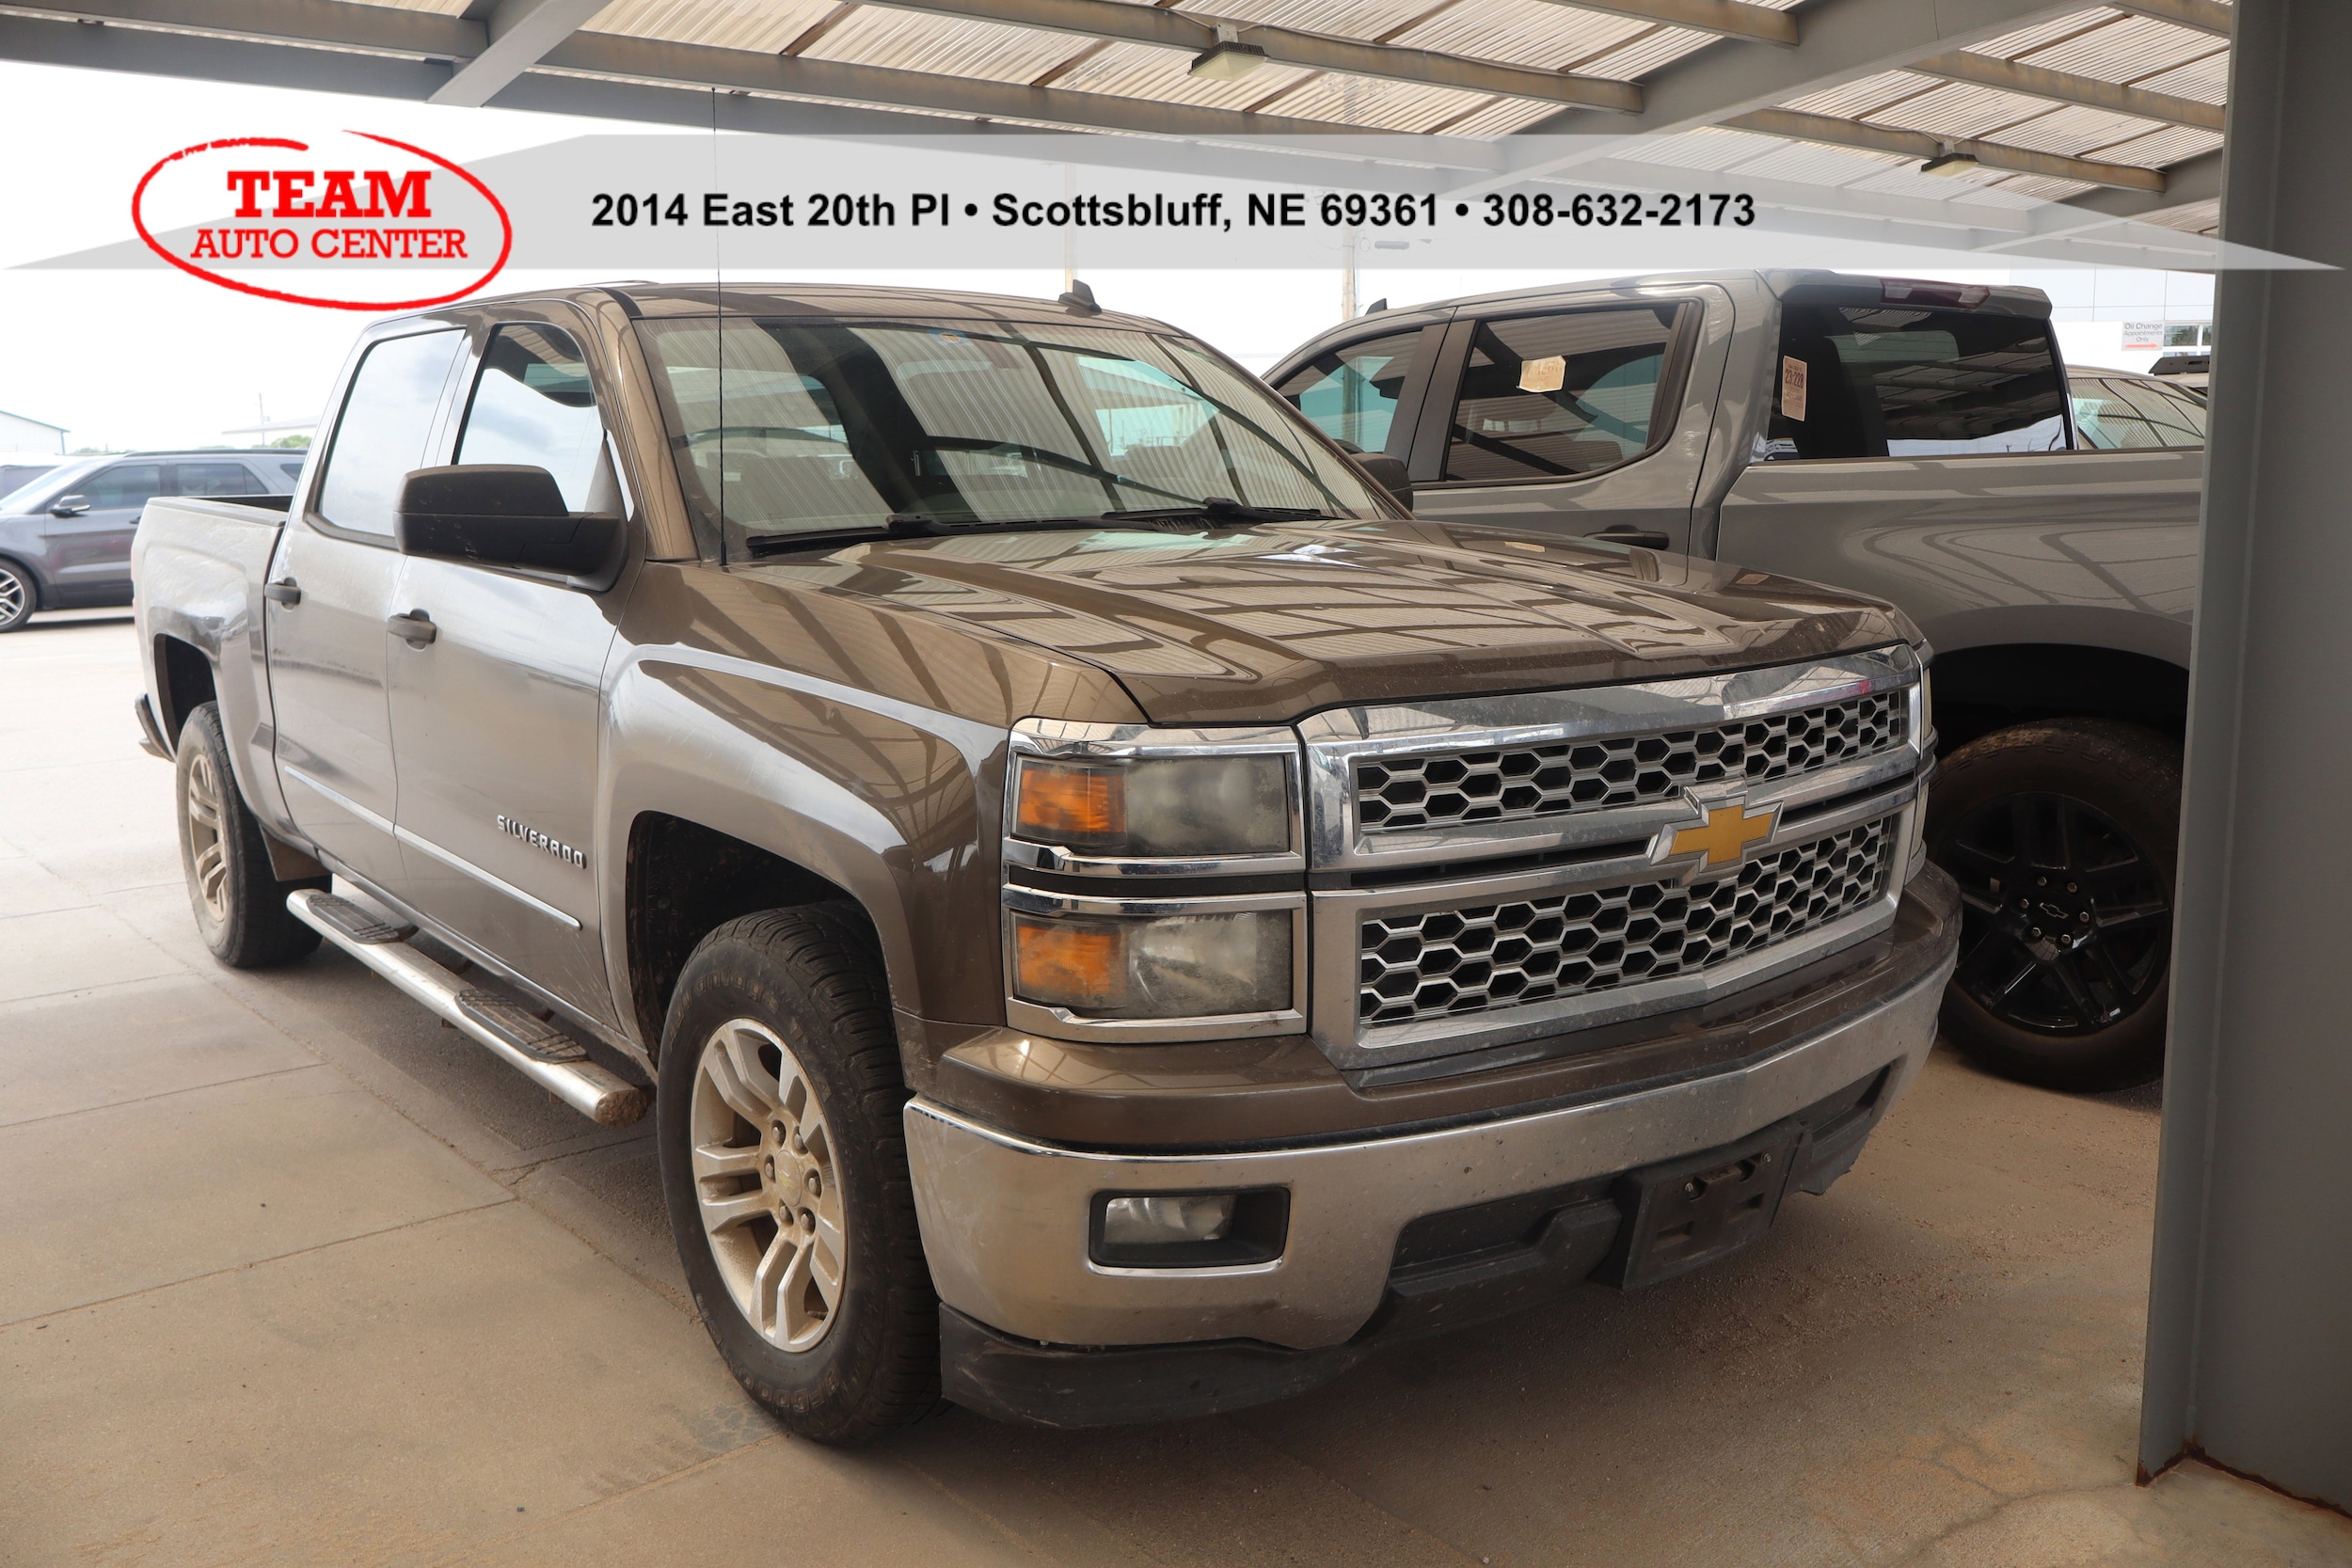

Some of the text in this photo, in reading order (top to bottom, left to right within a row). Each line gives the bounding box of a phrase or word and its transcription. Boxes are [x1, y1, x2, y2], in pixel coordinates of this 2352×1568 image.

[2124, 322, 2163, 330] Oil Change
[497, 815, 587, 870] SILVERADO
